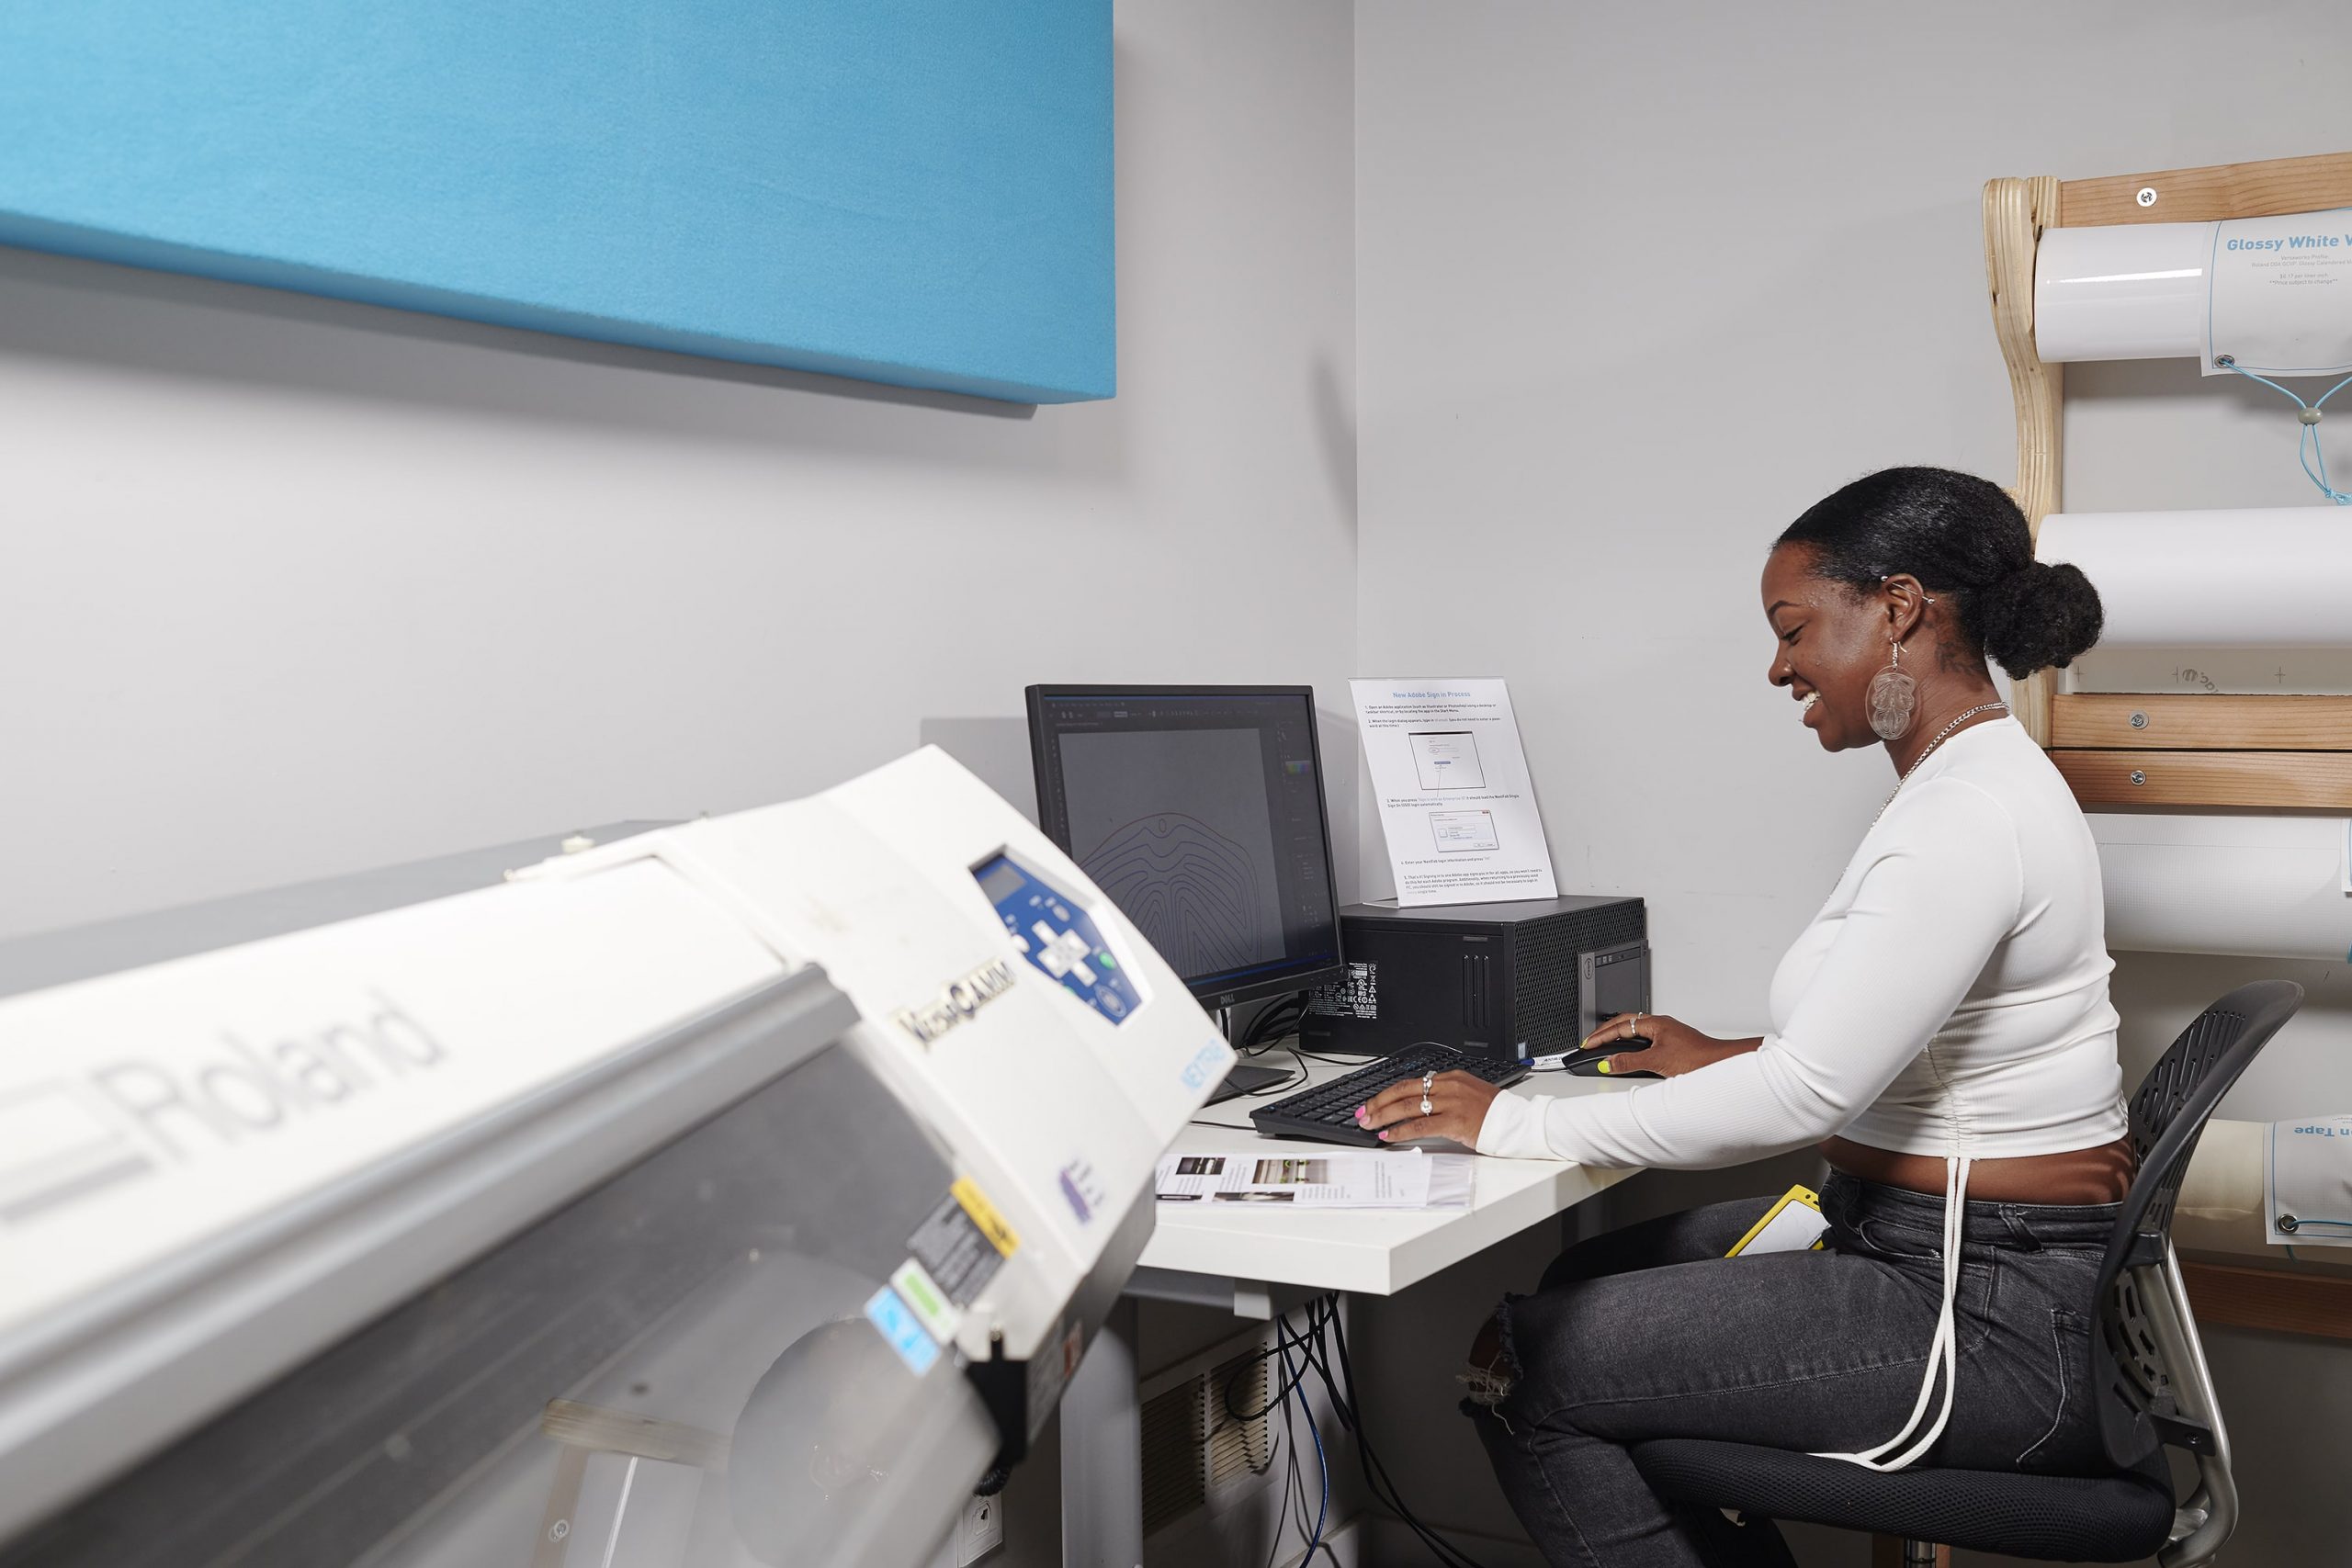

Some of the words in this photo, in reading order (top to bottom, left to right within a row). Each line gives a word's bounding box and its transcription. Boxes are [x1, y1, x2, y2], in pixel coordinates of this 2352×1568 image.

[2227, 239, 2285, 252] Glossy
[2289, 235, 2339, 249] White
[1426, 691, 1440, 699] Sign
[1220, 993, 1235, 1005] DELL
[89, 985, 447, 1163] Roland
[2294, 1126, 2335, 1137] Tape
